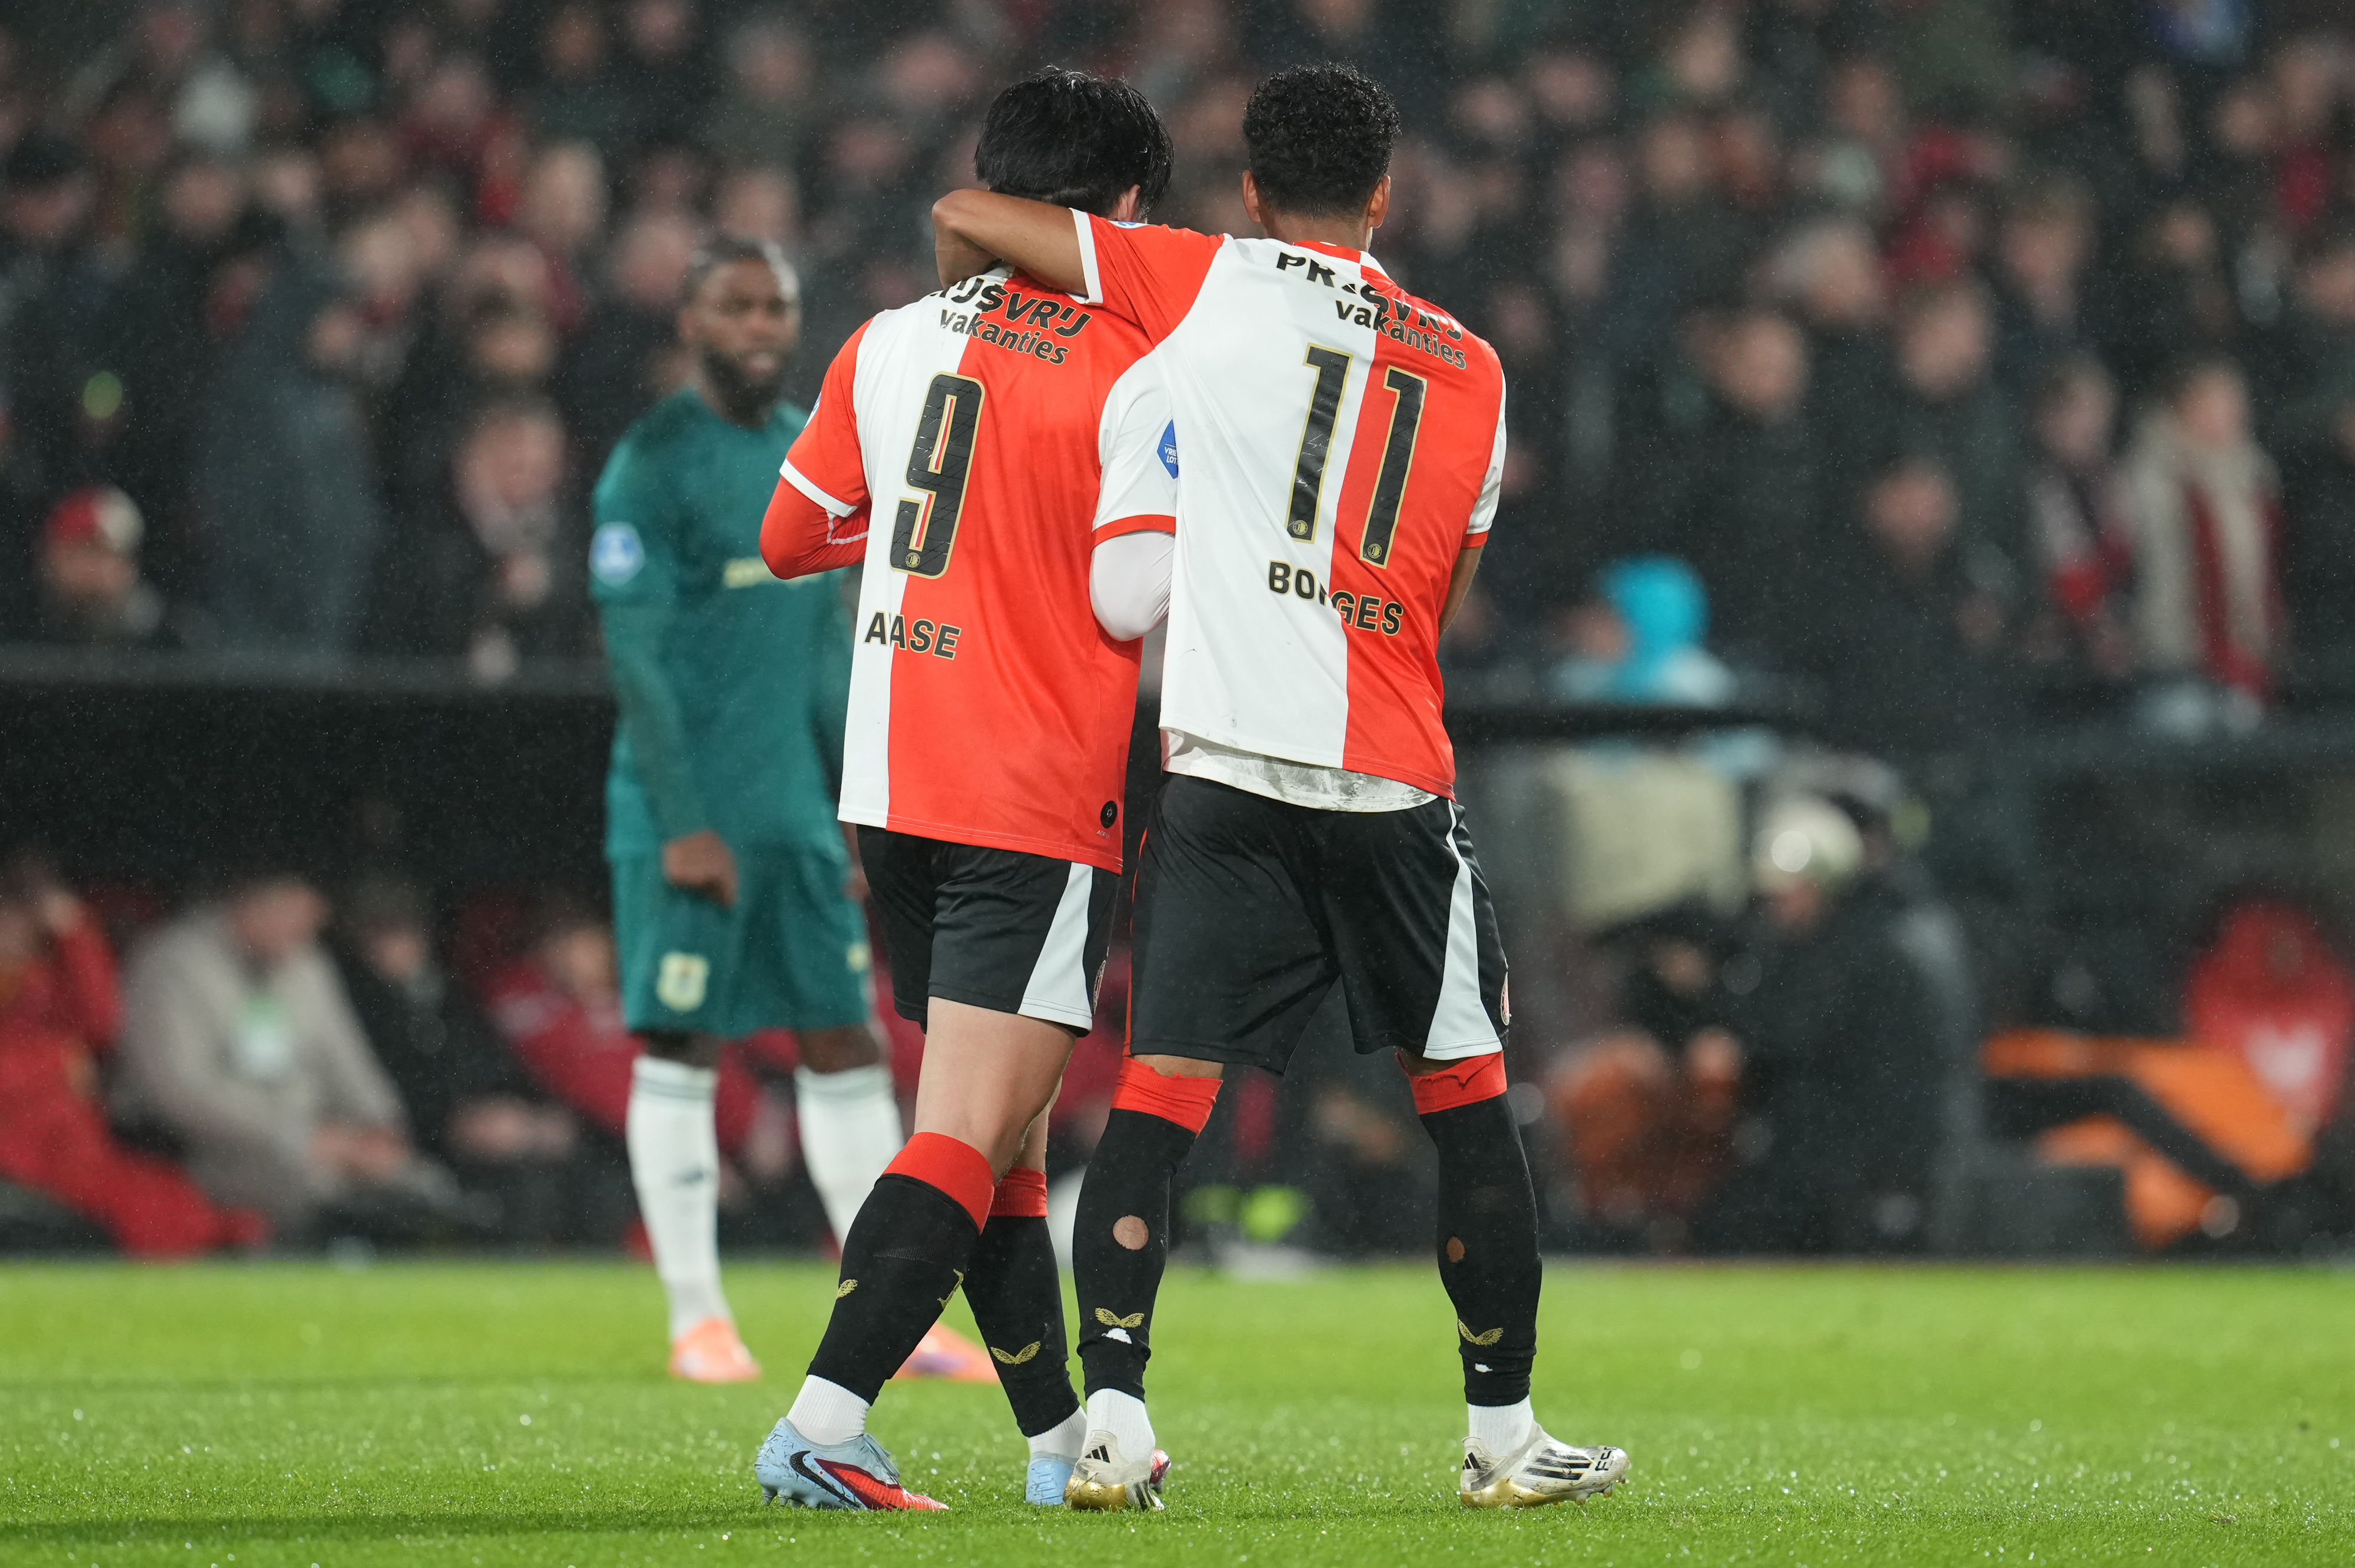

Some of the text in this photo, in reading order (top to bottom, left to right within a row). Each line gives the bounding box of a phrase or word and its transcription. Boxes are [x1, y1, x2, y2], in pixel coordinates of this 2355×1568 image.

[940, 308, 1070, 365] vakanties
[1335, 300, 1466, 370] vakanties
[890, 371, 986, 580] 9
[1285, 342, 1428, 569] 11
[863, 610, 962, 660] AASE
